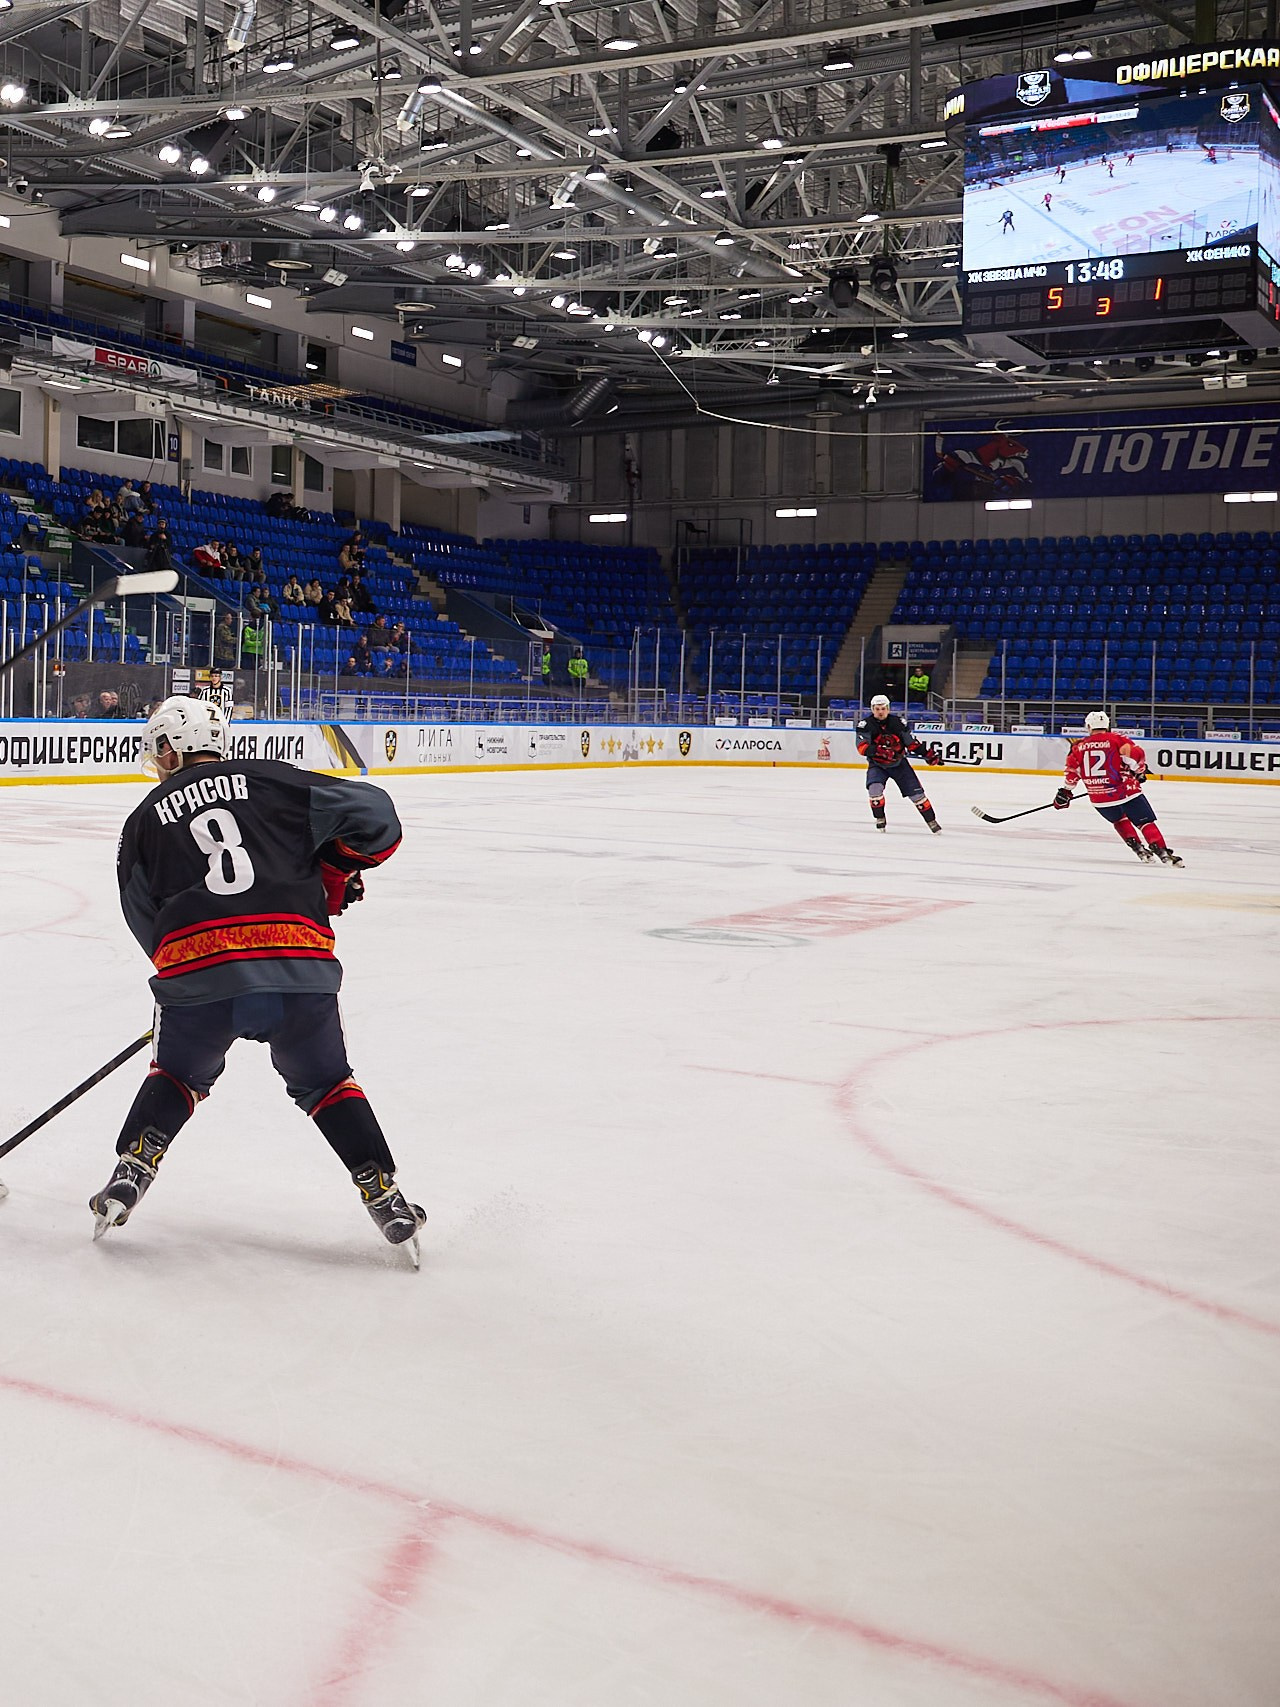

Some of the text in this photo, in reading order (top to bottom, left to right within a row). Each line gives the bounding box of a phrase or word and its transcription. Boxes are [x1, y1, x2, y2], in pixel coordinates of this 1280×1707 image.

[1117, 48, 1280, 86] ОФИЦЕРСКАЯ
[1186, 244, 1251, 262] ХК ФЕНИКС
[983, 267, 1023, 283] ЗВЕЗДА
[1065, 258, 1123, 284] 13:48
[1047, 287, 1063, 310] 5
[1154, 278, 1162, 300] 1
[1096, 297, 1111, 316] 3
[107, 354, 148, 373] SPAR
[244, 384, 298, 411] TANK
[170, 437, 178, 451] 10
[1061, 427, 1279, 475] ЛЮТЫЕ
[265, 736, 304, 760] ЛИГА
[417, 729, 453, 748] ЛИГА
[486, 736, 504, 744] НИЖНИЙ
[733, 740, 782, 751] АЛРОСА
[419, 753, 452, 763] СИЛЬНЫХ
[486, 746, 508, 754] НОВГОРОД
[1083, 750, 1107, 777] 12
[154, 774, 249, 825] КРАСОВ
[189, 808, 255, 895] 8
